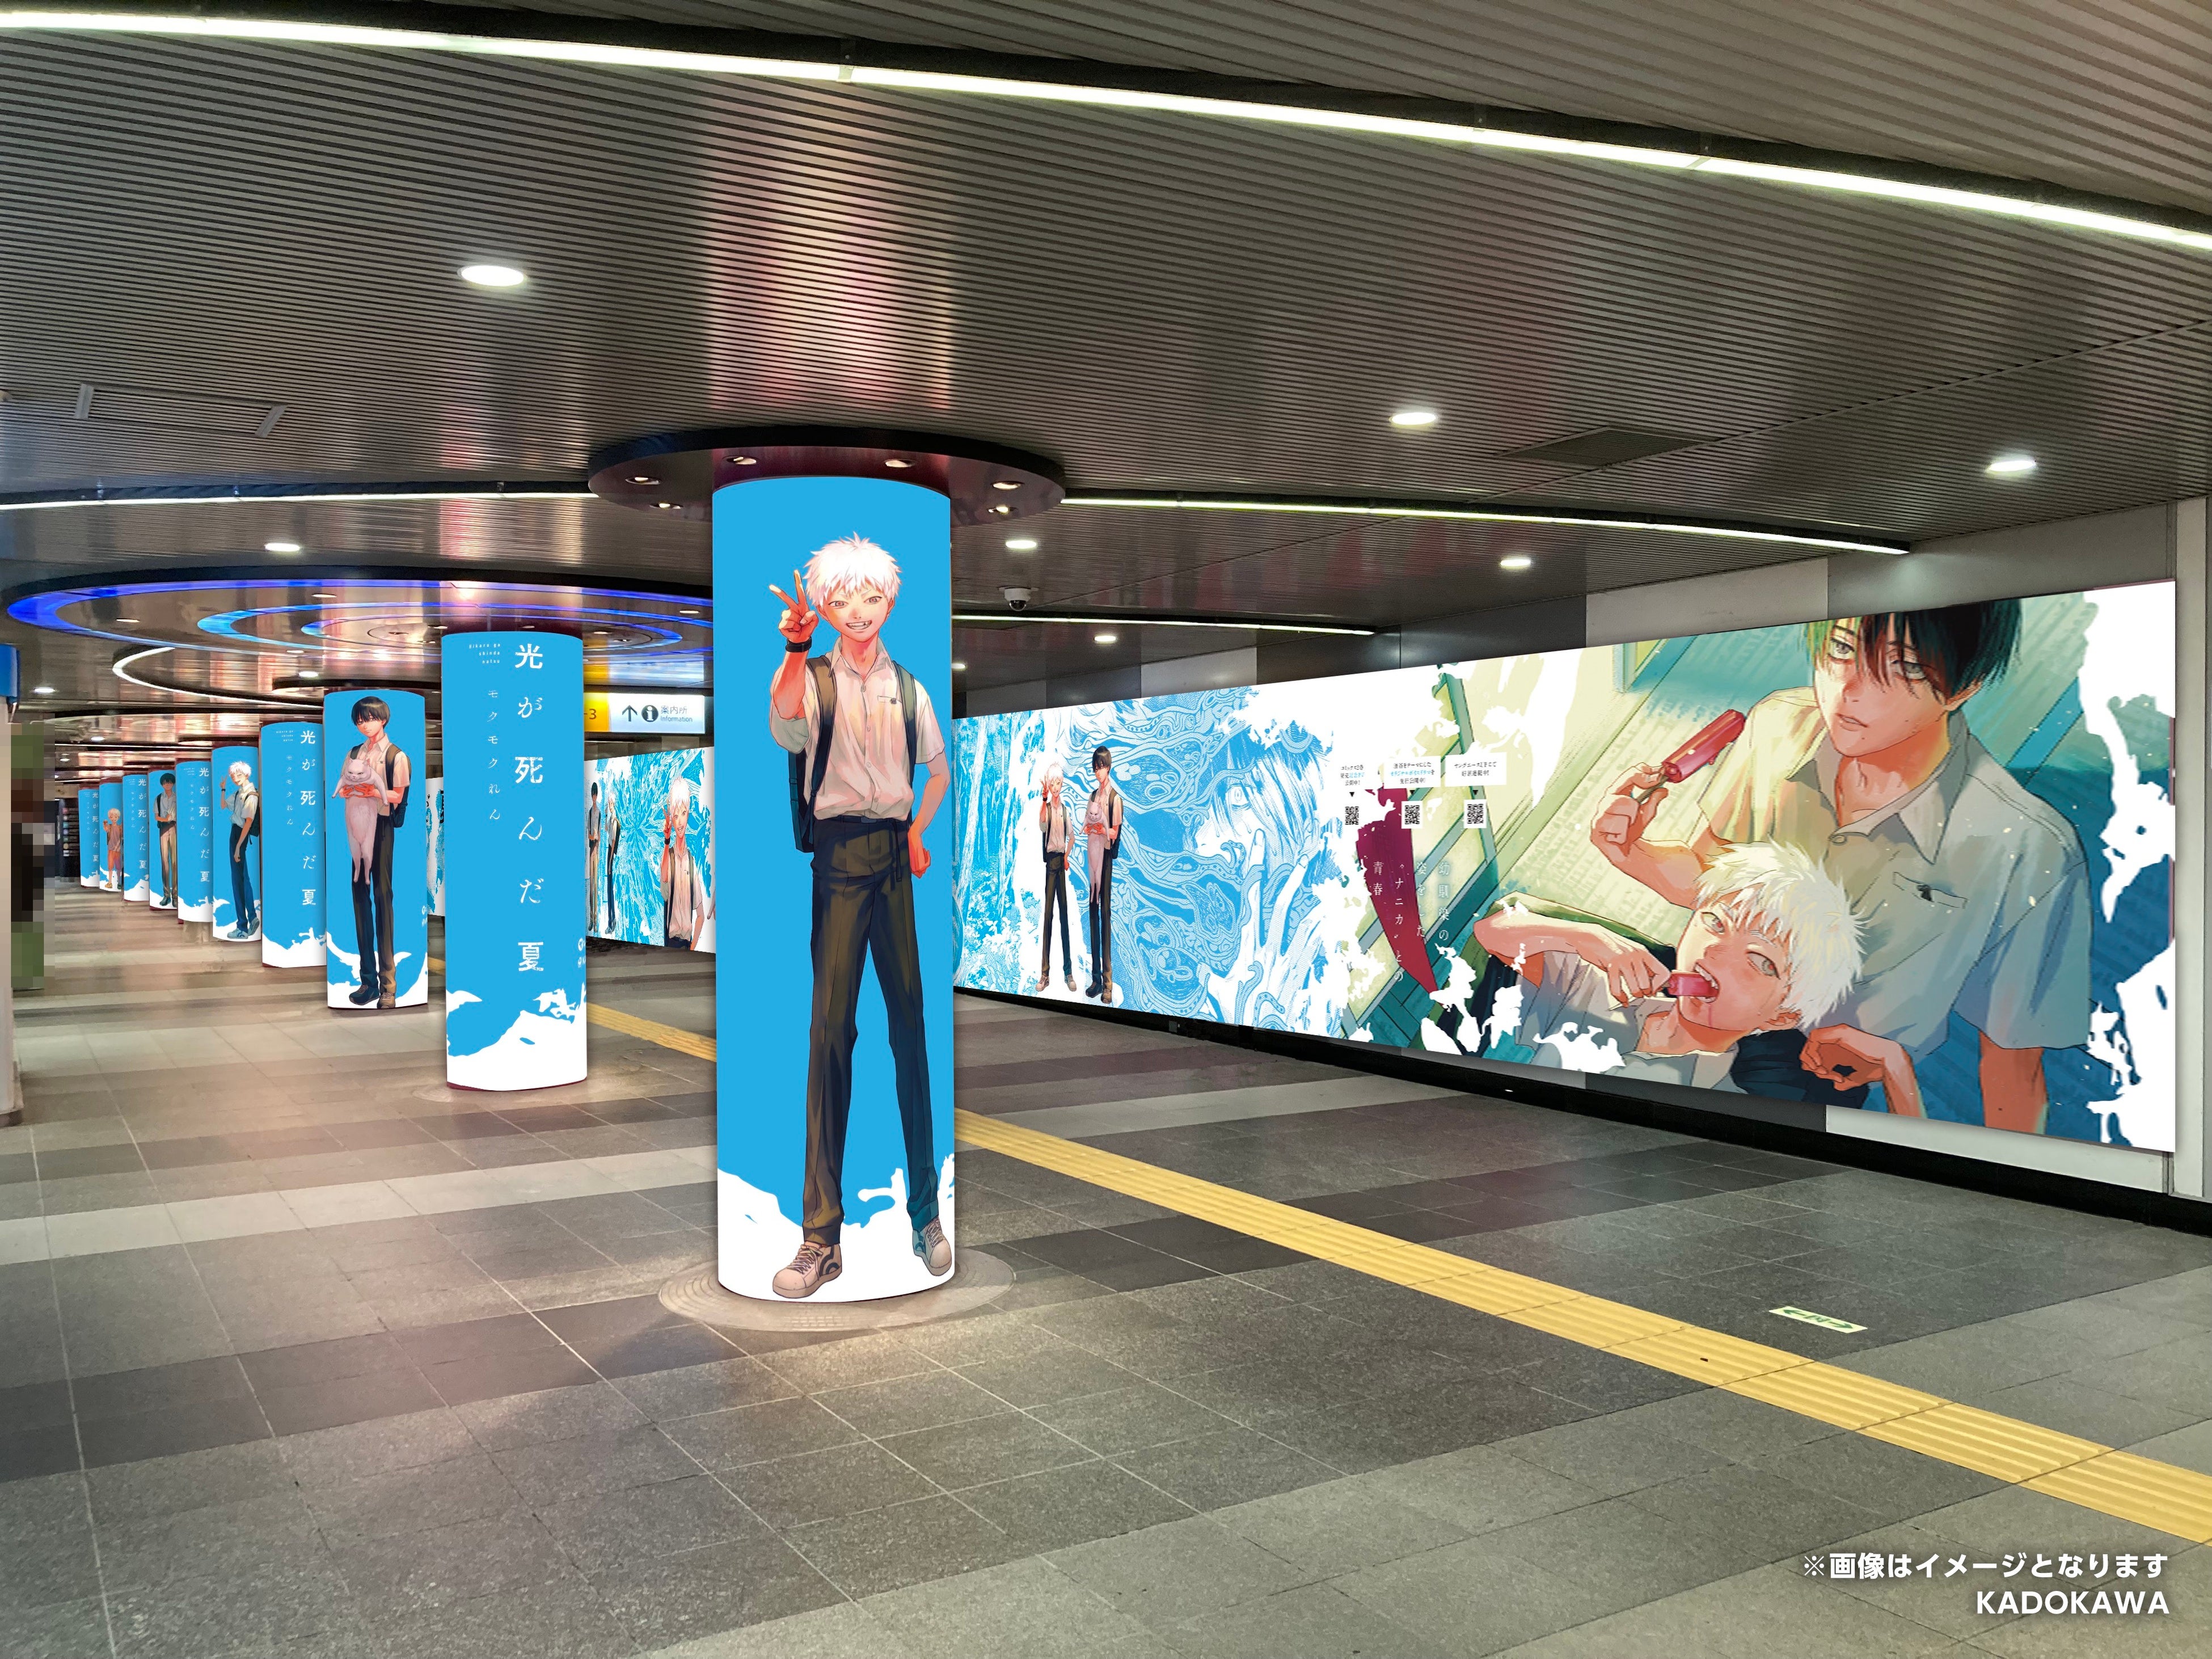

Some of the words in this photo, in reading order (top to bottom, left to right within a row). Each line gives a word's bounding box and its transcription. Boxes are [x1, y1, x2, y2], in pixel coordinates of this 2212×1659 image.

[487, 690, 500, 820] モクモクれん
[661, 706, 687, 714] 案内所
[138, 778, 147, 869] 光が死んだ夏
[199, 767, 210, 882] 光が死んだ夏
[300, 730, 316, 905] 光が死んだ夏
[514, 643, 544, 972] 光が死んだ夏
[1373, 861, 1383, 896] 青春
